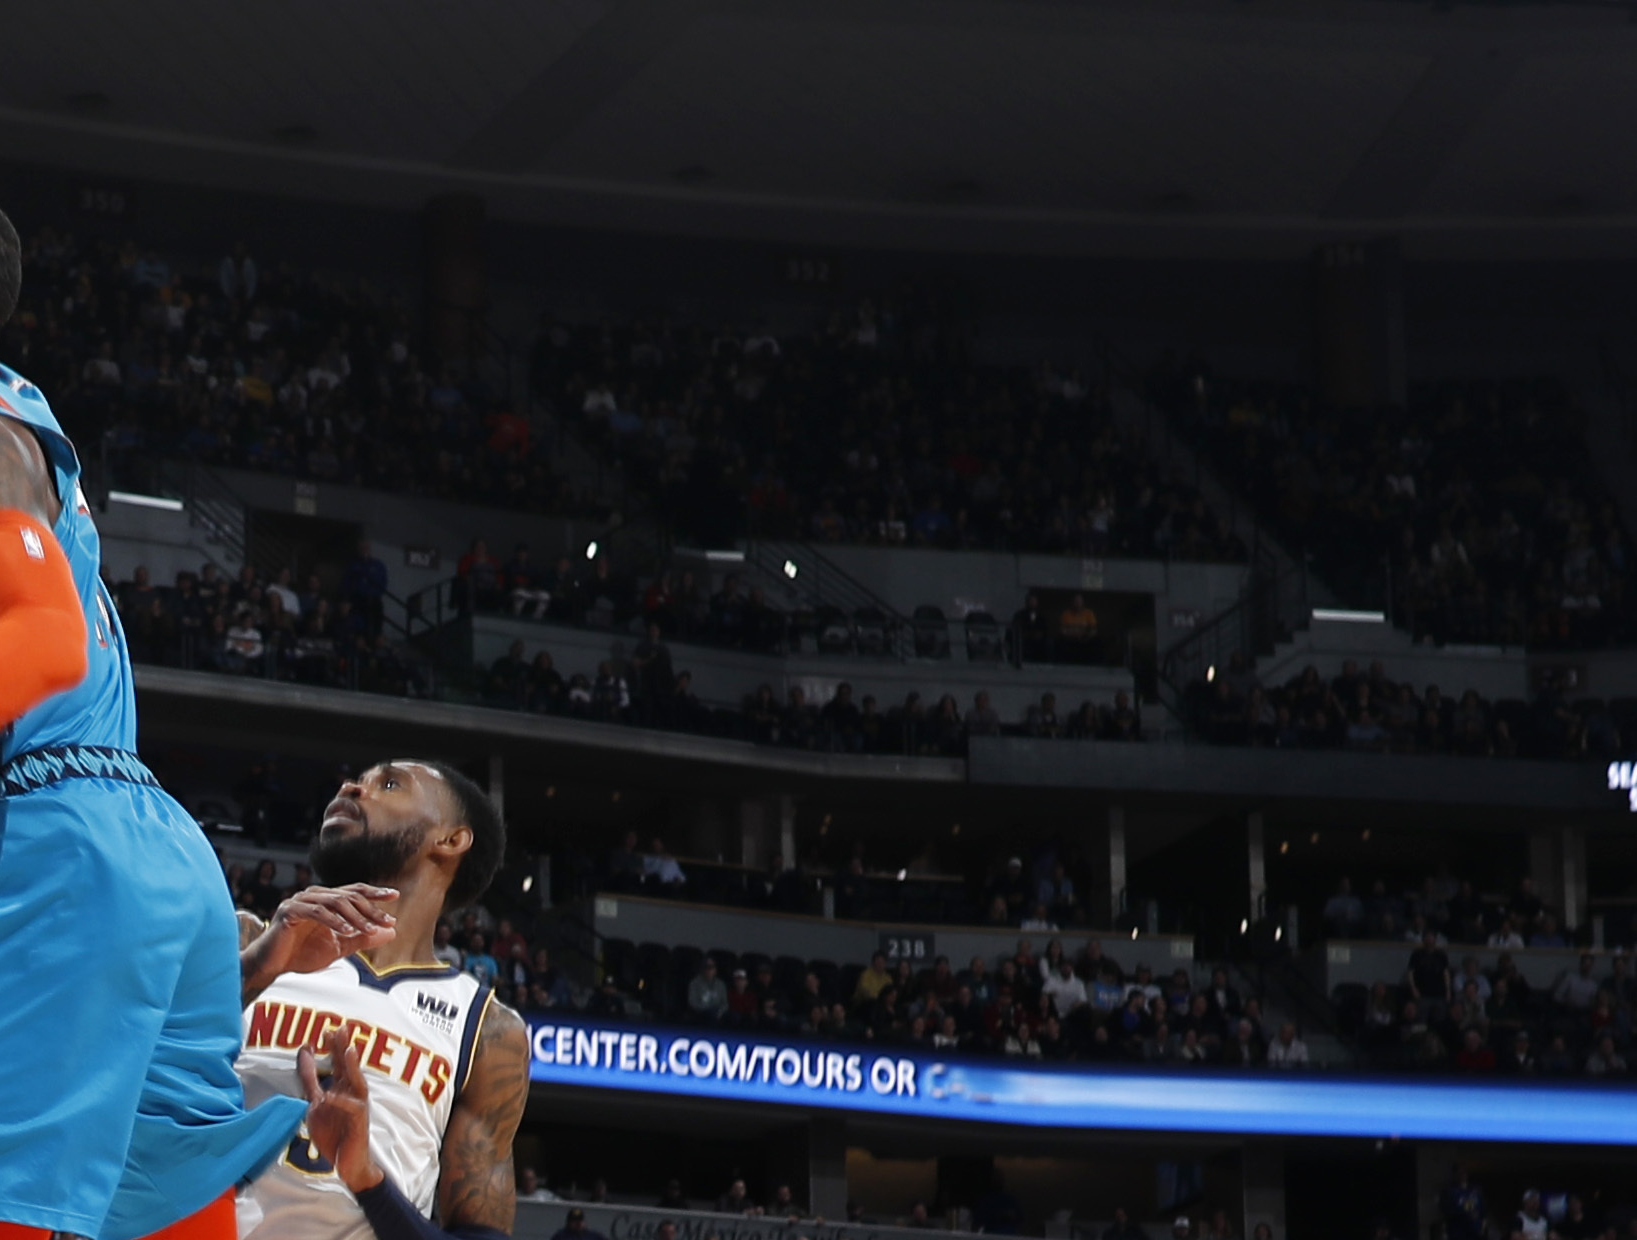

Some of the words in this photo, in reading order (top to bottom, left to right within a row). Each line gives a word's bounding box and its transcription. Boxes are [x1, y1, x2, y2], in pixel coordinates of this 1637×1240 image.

[888, 938, 926, 960] 238
[246, 1001, 451, 1105] NUGGETS
[870, 1057, 917, 1097] OR
